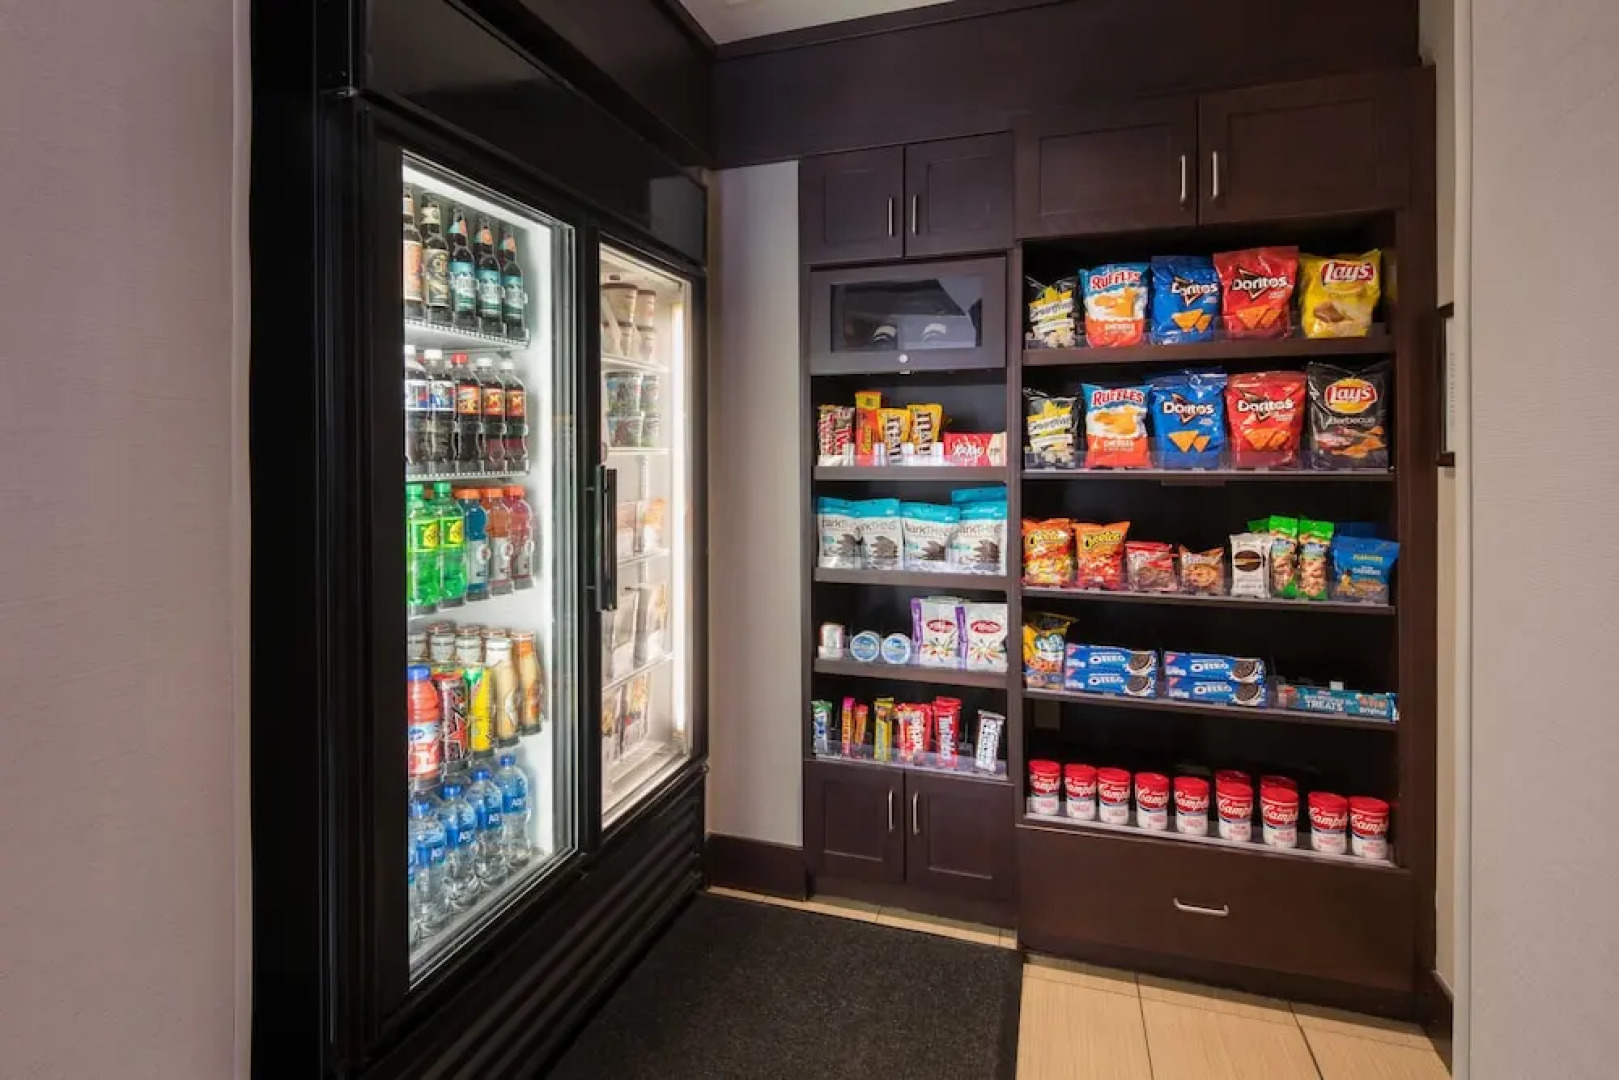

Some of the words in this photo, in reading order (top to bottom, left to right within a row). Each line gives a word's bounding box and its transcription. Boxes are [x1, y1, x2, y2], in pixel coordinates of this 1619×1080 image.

[1171, 282, 1218, 294] Doritos
[1231, 276, 1288, 291] Doritos
[1092, 389, 1144, 407] RUFFLES
[1162, 401, 1215, 415] Doritos
[1237, 399, 1295, 413] Doritos
[1088, 653, 1126, 665] OREO
[1190, 660, 1230, 673] OREO
[1088, 674, 1125, 686] OREO
[1194, 682, 1233, 696] OREO
